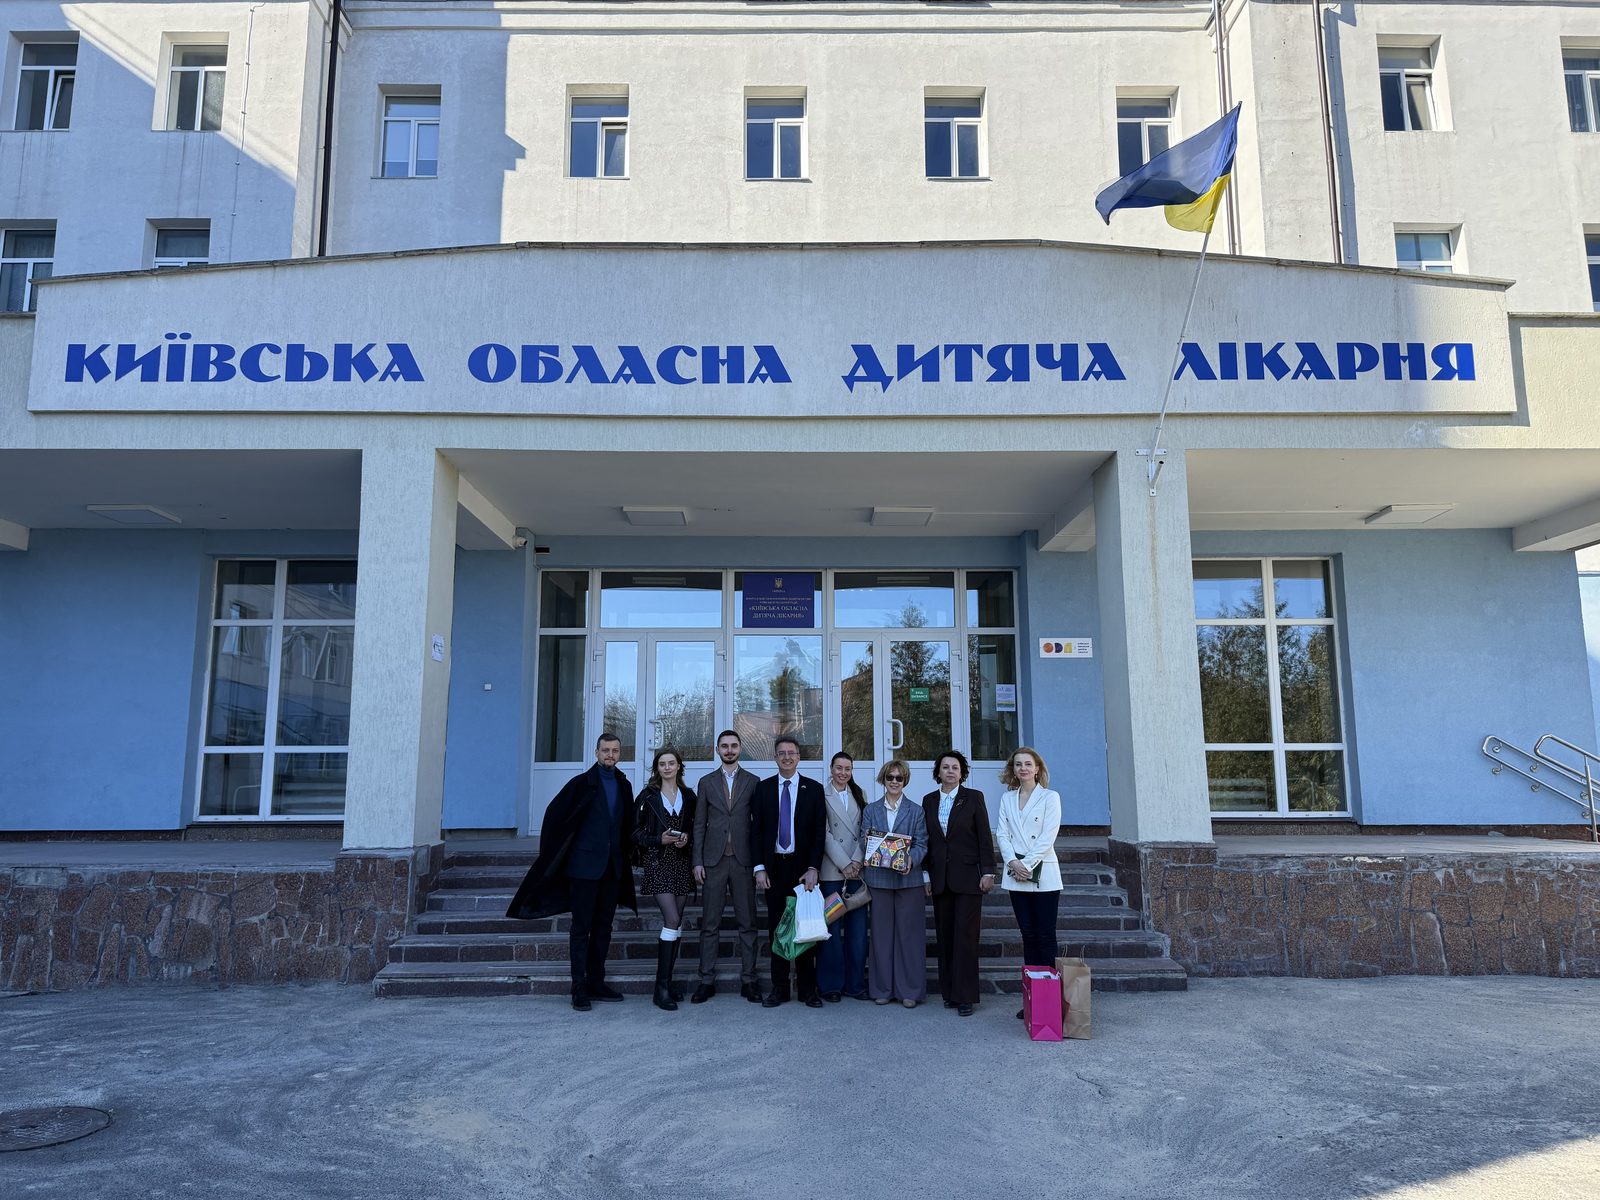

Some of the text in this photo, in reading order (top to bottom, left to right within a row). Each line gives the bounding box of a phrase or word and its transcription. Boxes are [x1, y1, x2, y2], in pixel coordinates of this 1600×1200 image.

[65, 332, 1476, 394] КИЇВСЬКА ОБЛАСНА ДИТЯЧА ЛІКАРНЯ
